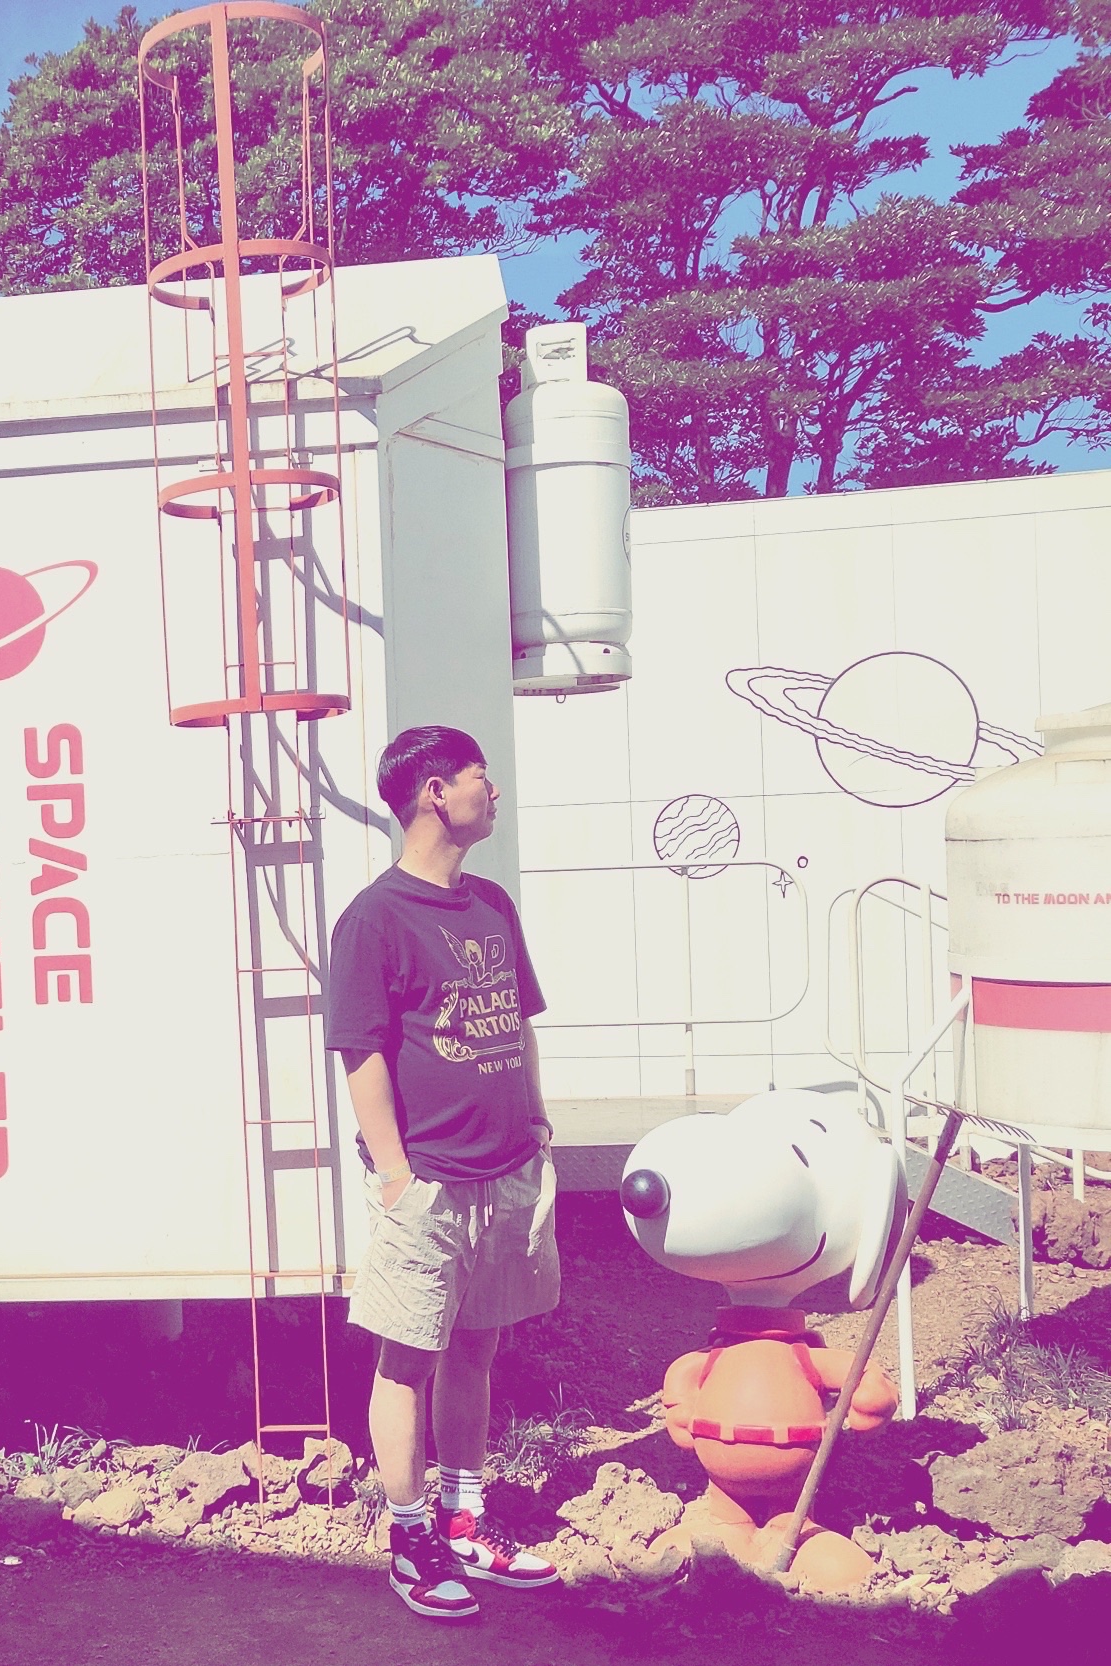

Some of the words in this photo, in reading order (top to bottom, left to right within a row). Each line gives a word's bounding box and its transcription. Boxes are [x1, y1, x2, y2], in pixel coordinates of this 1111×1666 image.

[24, 723, 93, 1005] SPACE
[995, 893, 1010, 904] TO
[1014, 893, 1039, 904] THE
[1043, 893, 1090, 904] MOON
[459, 988, 518, 1019] PALACE
[464, 1011, 521, 1039] ARTOIS
[477, 1060, 503, 1075] NEW
